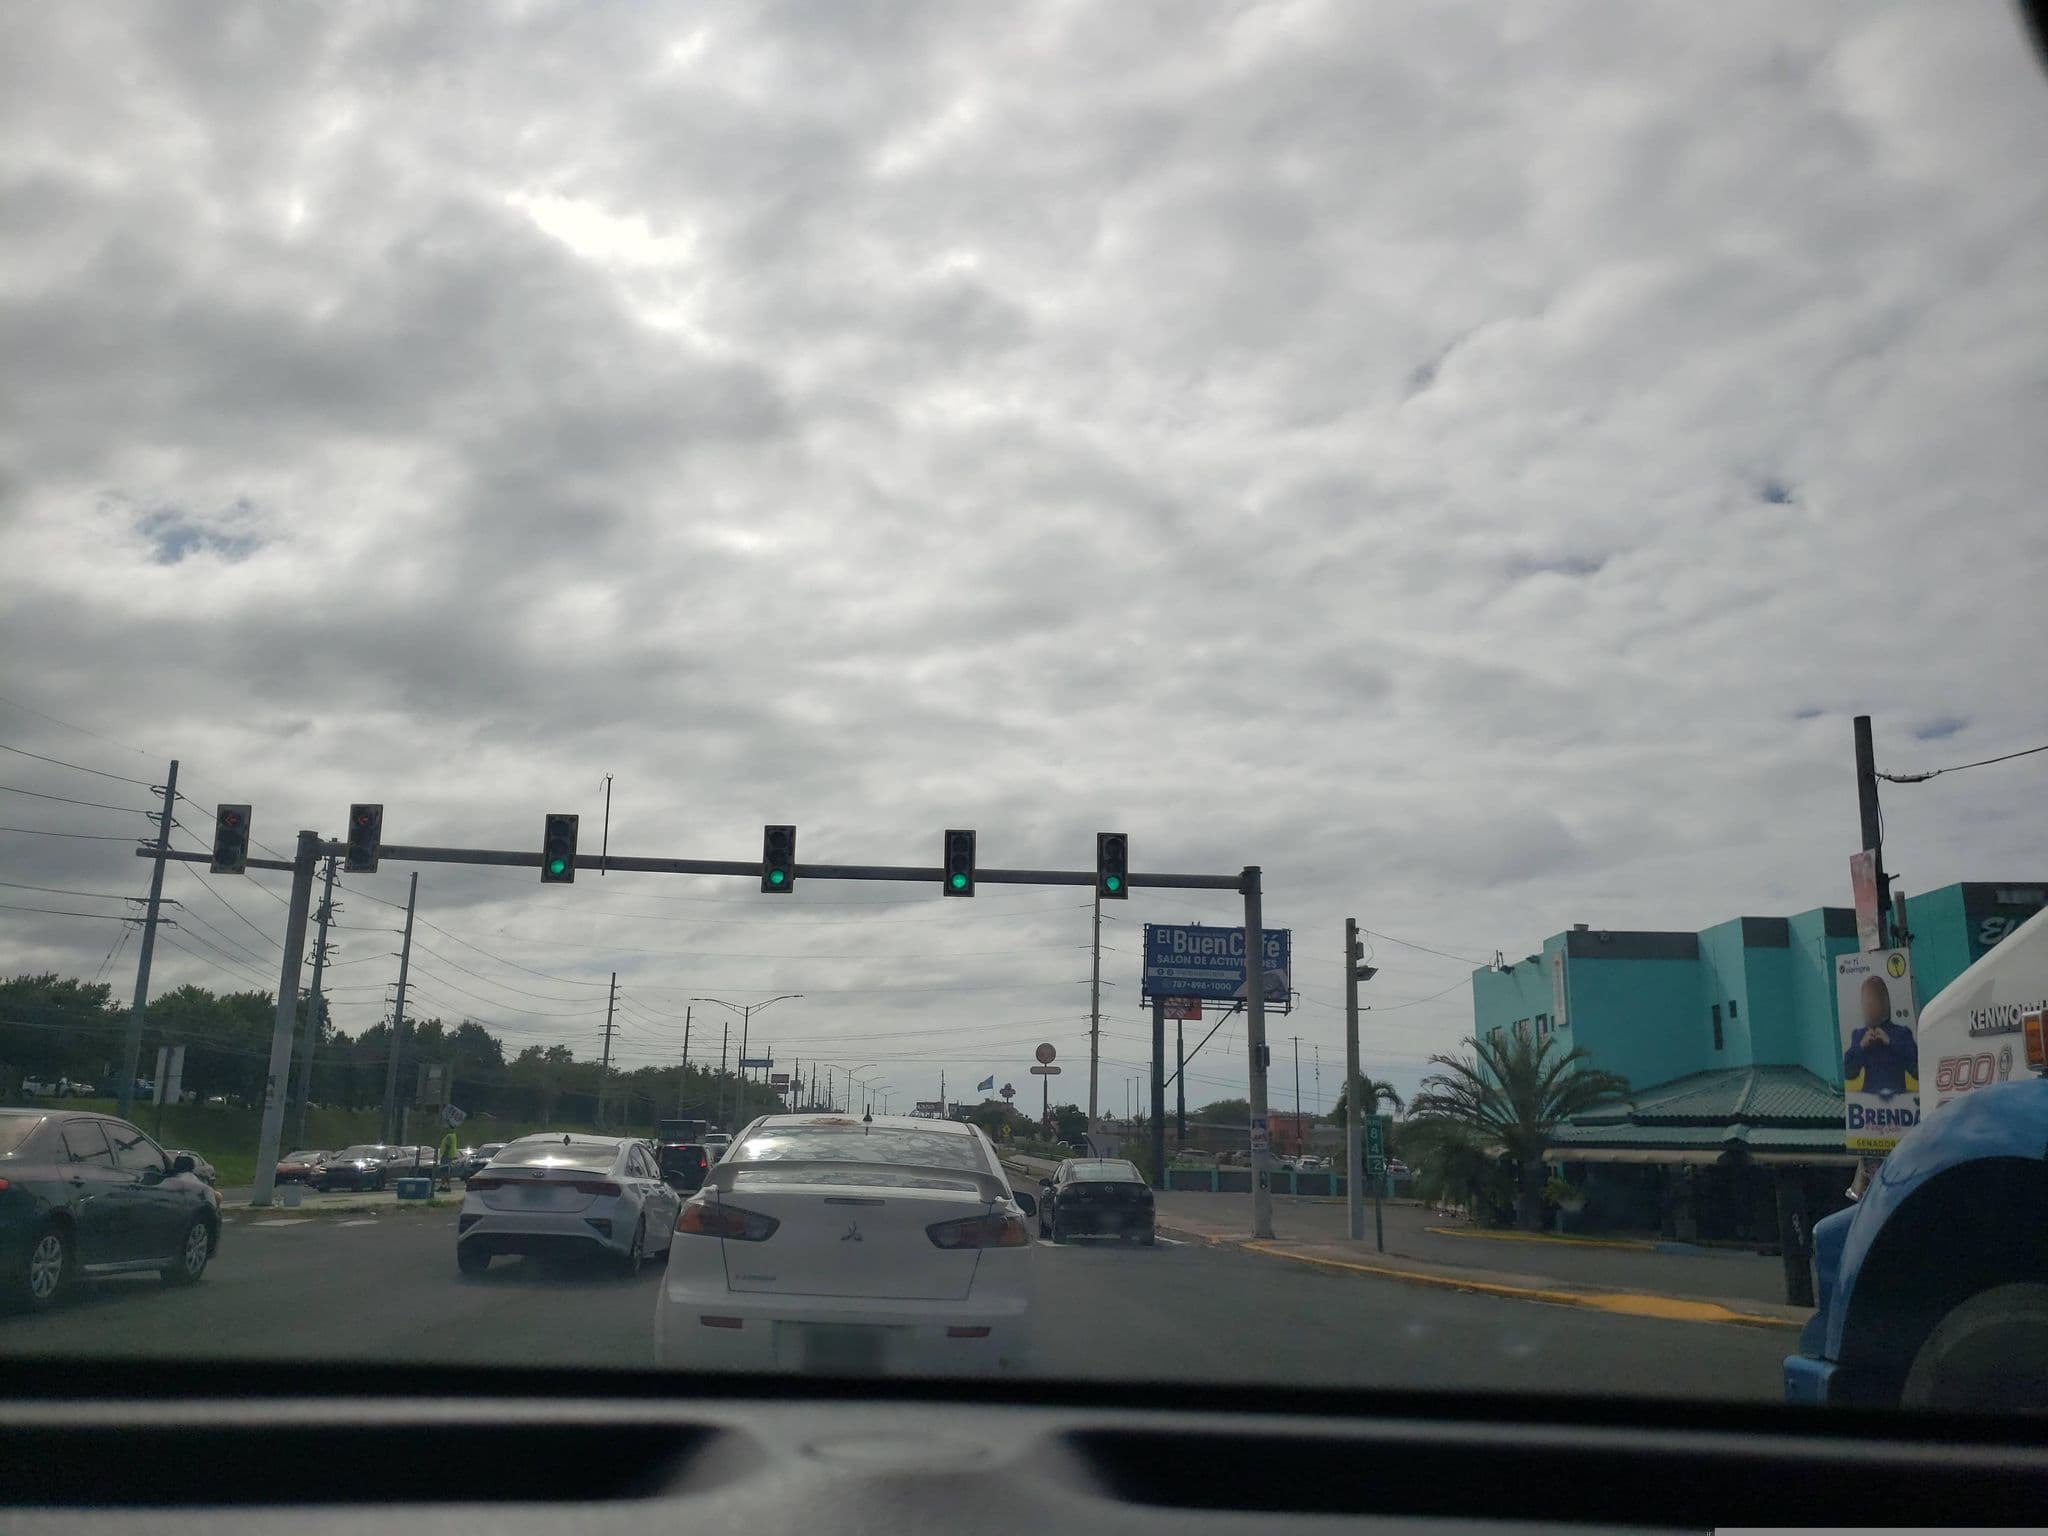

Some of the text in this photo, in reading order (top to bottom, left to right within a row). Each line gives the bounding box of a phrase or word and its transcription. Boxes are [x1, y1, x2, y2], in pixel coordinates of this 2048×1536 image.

[1157, 929, 1281, 958] El Buen Cfé
[1157, 955, 1191, 964] SALON
[1194, 956, 1207, 965] DE
[1968, 1000, 2048, 1030] KENWO
[1370, 1128, 1378, 1139] 8
[1371, 1143, 1379, 1154] 4
[1374, 1159, 1381, 1170] 2
